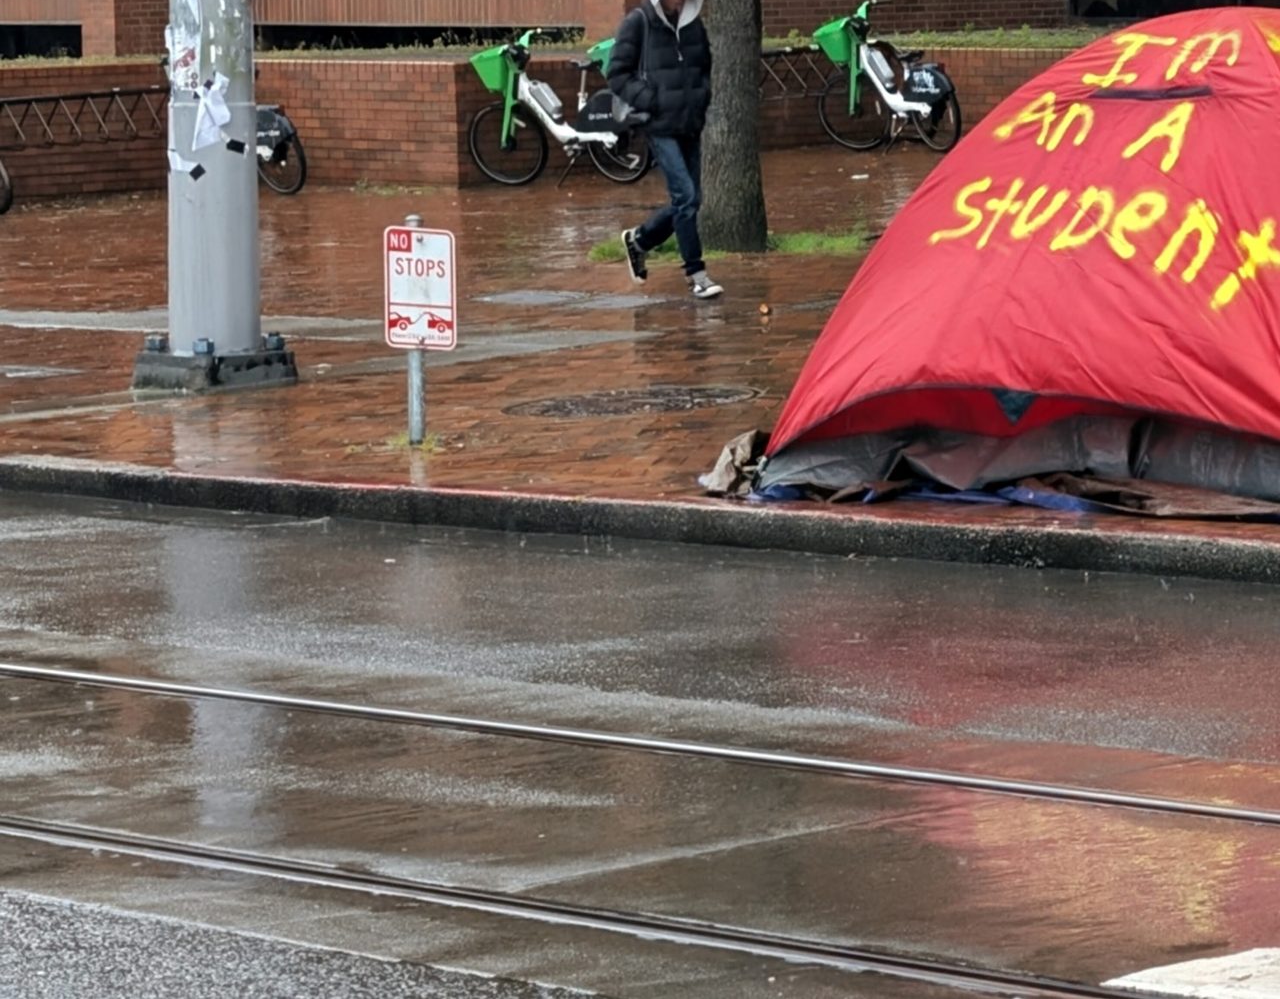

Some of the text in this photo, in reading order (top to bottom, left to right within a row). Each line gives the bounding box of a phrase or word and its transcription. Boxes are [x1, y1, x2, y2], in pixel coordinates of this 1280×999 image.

[1121, 101, 1195, 173] A
[389, 233, 409, 249] NO
[394, 257, 446, 278] STOPS
